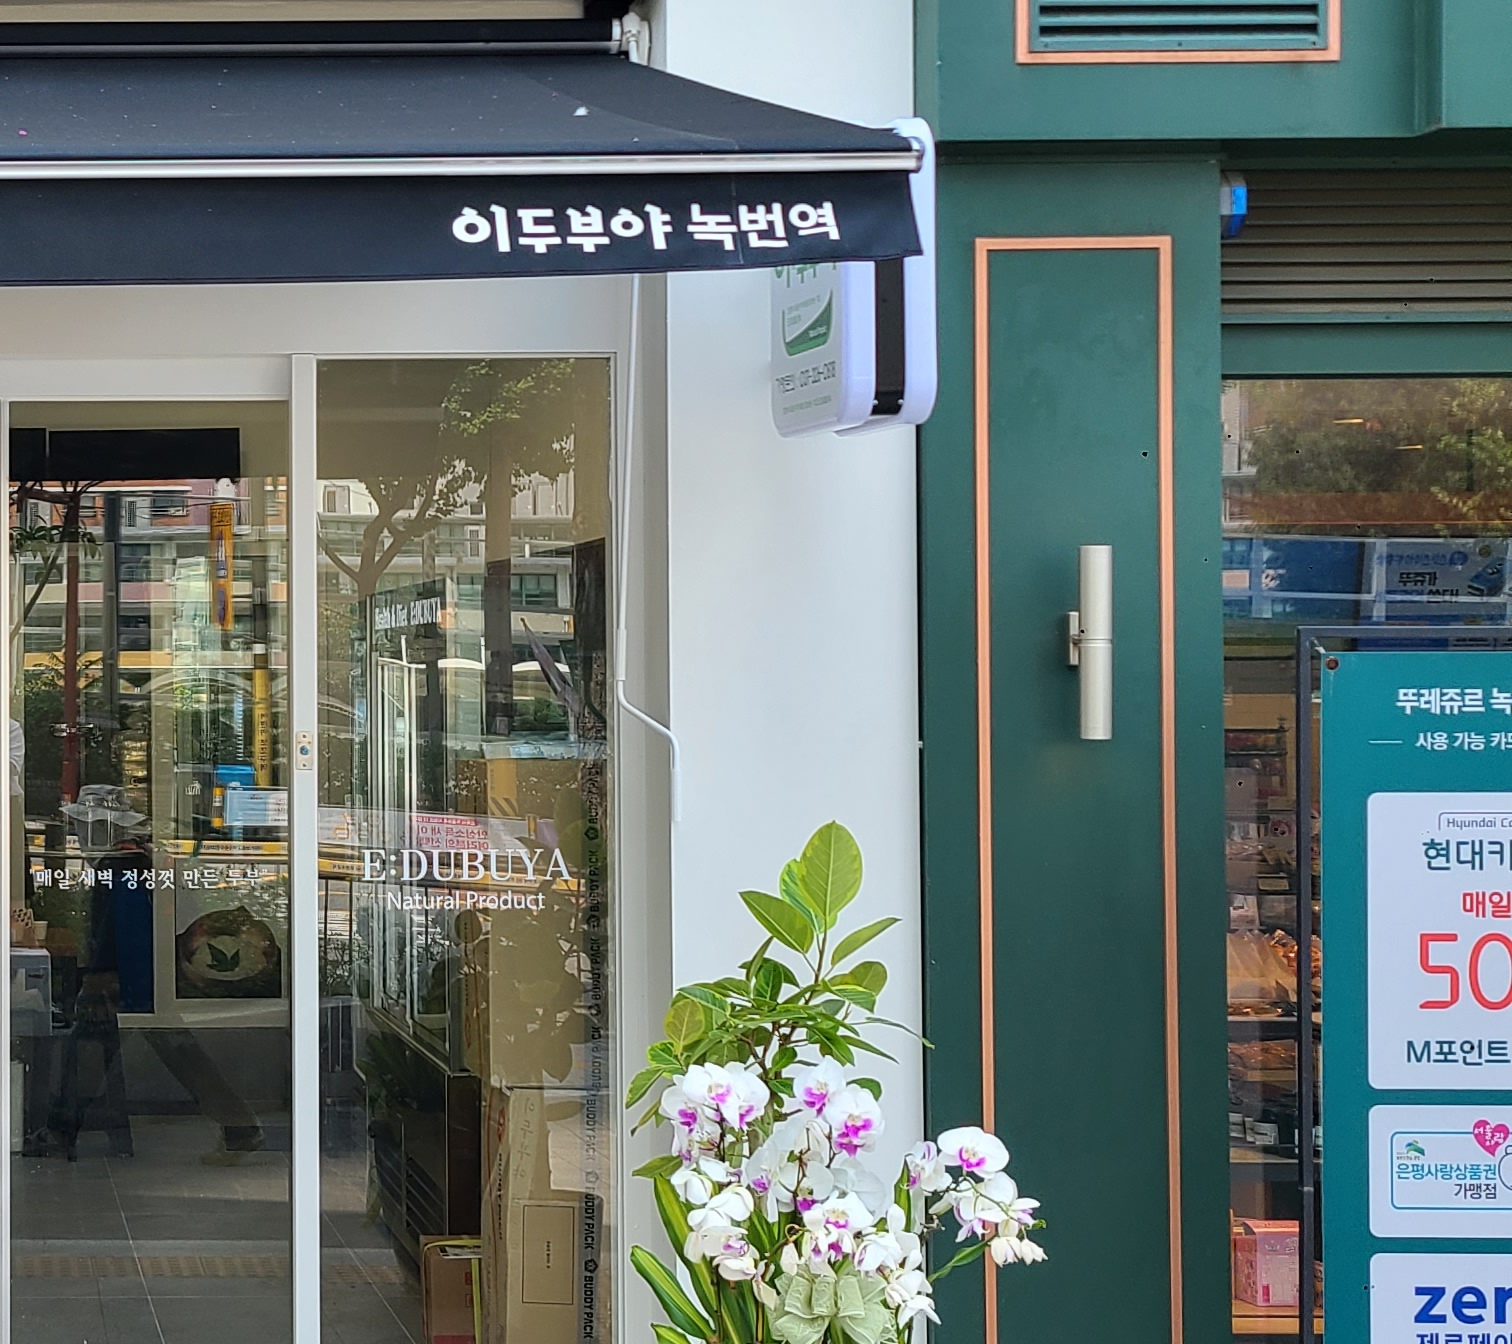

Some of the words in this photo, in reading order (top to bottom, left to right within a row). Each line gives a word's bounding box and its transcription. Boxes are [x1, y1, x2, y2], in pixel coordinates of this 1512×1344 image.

[451, 202, 674, 254] 이두부야
[687, 200, 841, 251] 녹번역
[1396, 688, 1486, 717] 뚜레쥬르
[1414, 732, 1449, 751] 사용
[1452, 732, 1487, 751] 가능
[1446, 817, 1497, 833] Hyundai
[361, 846, 572, 882] E:DUBUYA
[78, 867, 114, 890] 새벽
[120, 866, 176, 891] 정성껏
[182, 867, 222, 890] 만든
[387, 891, 461, 911] Natural
[466, 890, 546, 911] Product
[1462, 891, 1512, 919] 매일
[1405, 1038, 1512, 1068] M포인트
[1395, 1163, 1497, 1181] 은평사랑상품권
[1453, 1182, 1498, 1201] 가맹점
[582, 1274, 597, 1311] BUDDY
[582, 1311, 597, 1340] PACK
